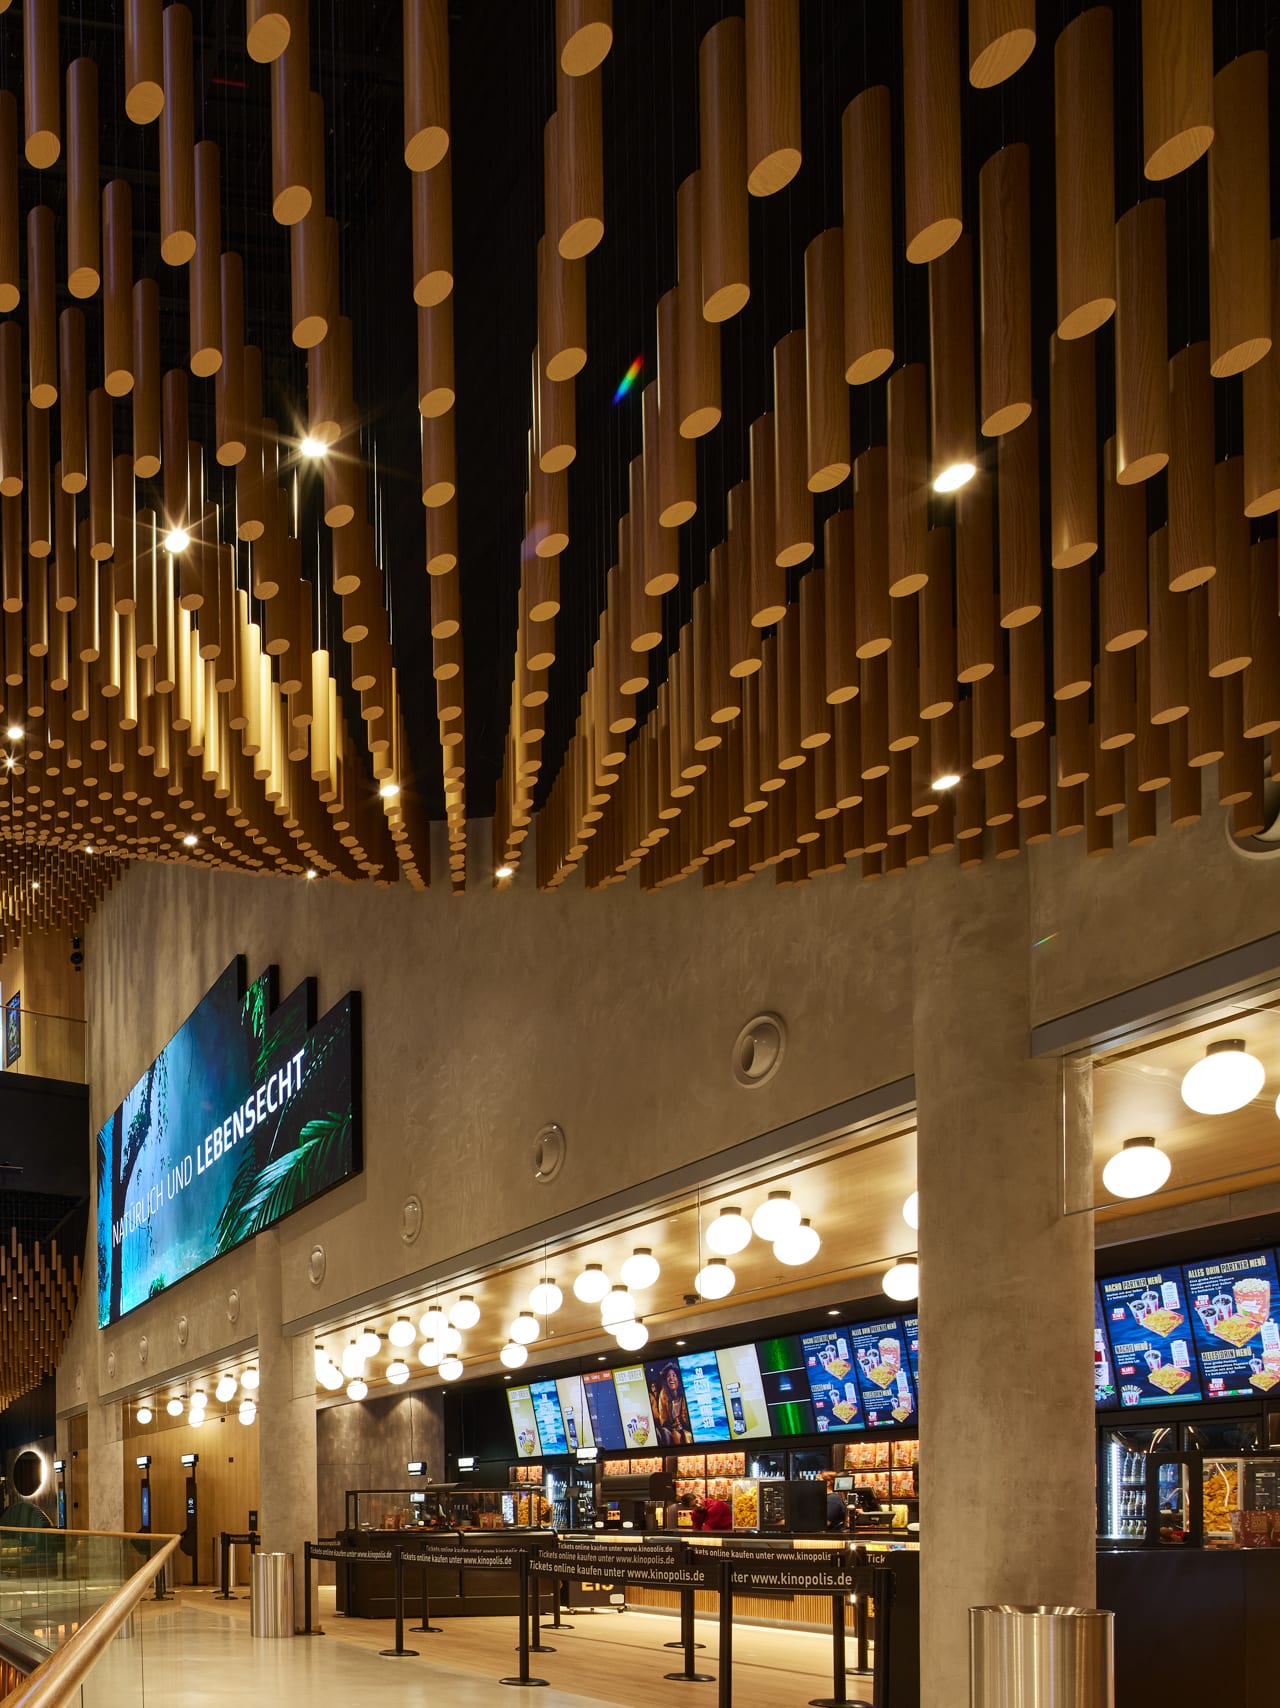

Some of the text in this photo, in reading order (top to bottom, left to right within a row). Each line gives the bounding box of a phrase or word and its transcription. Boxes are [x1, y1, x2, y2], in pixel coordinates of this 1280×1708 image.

[113, 1049, 305, 1248] NATÜRLICH UND LEBENSECHT
[1221, 1260, 1249, 1273] PARTNER
[558, 1542, 574, 1550] Tickets
[575, 1543, 590, 1551] online
[590, 1543, 608, 1552] kaufen
[401, 1552, 512, 1566] Tickets online kaufen unter www.kinopolis.de
[538, 1550, 675, 1565] Tickets online kaufen unter www.kinopolis.de
[710, 1548, 730, 1558] online
[731, 1549, 755, 1559] kaufen
[756, 1552, 775, 1560] unter
[776, 1552, 832, 1563] www.kinopolis
[866, 1553, 886, 1564] Tick
[529, 1560, 705, 1583] Tickets online kaufen unter www.kinopolis.de
[731, 1571, 853, 1588] ter www.kinopolis.de
